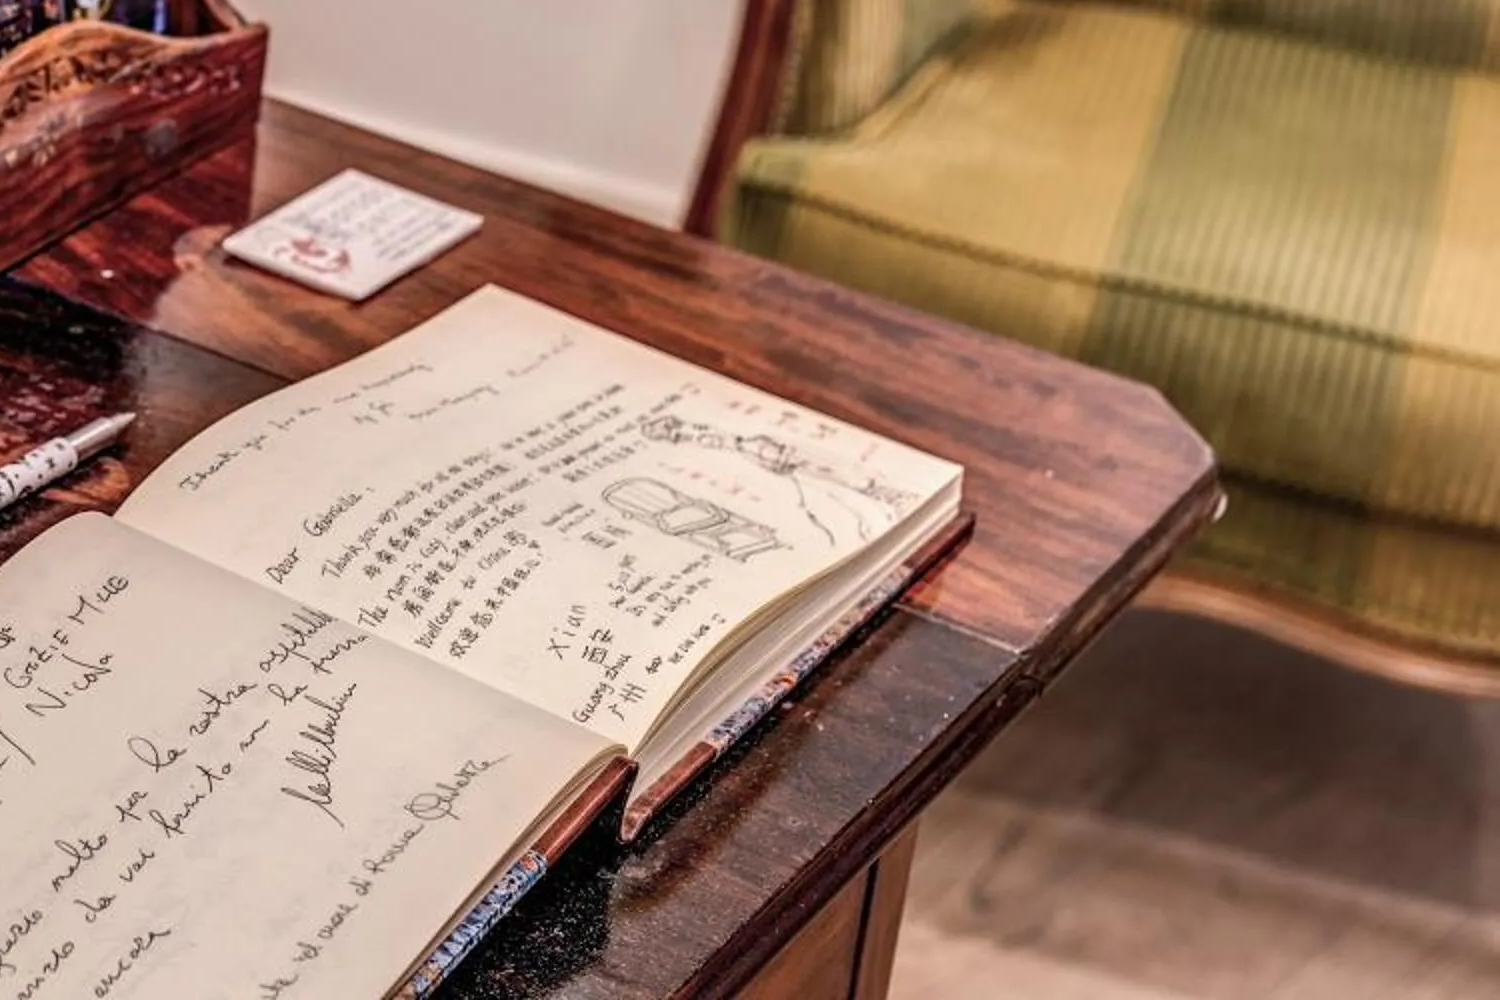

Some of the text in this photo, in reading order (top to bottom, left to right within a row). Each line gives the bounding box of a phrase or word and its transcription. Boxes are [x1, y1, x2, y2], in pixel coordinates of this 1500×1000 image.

[265, 547, 302, 585] Dear
[321, 544, 364, 578] Thank
[358, 526, 380, 550] you
[357, 604, 389, 628] The
[189, 682, 258, 737] vostra
[127, 735, 188, 774] la
[115, 790, 150, 823] per
[73, 893, 118, 924] da
[119, 849, 156, 884] voi
[149, 762, 232, 839] fornito
